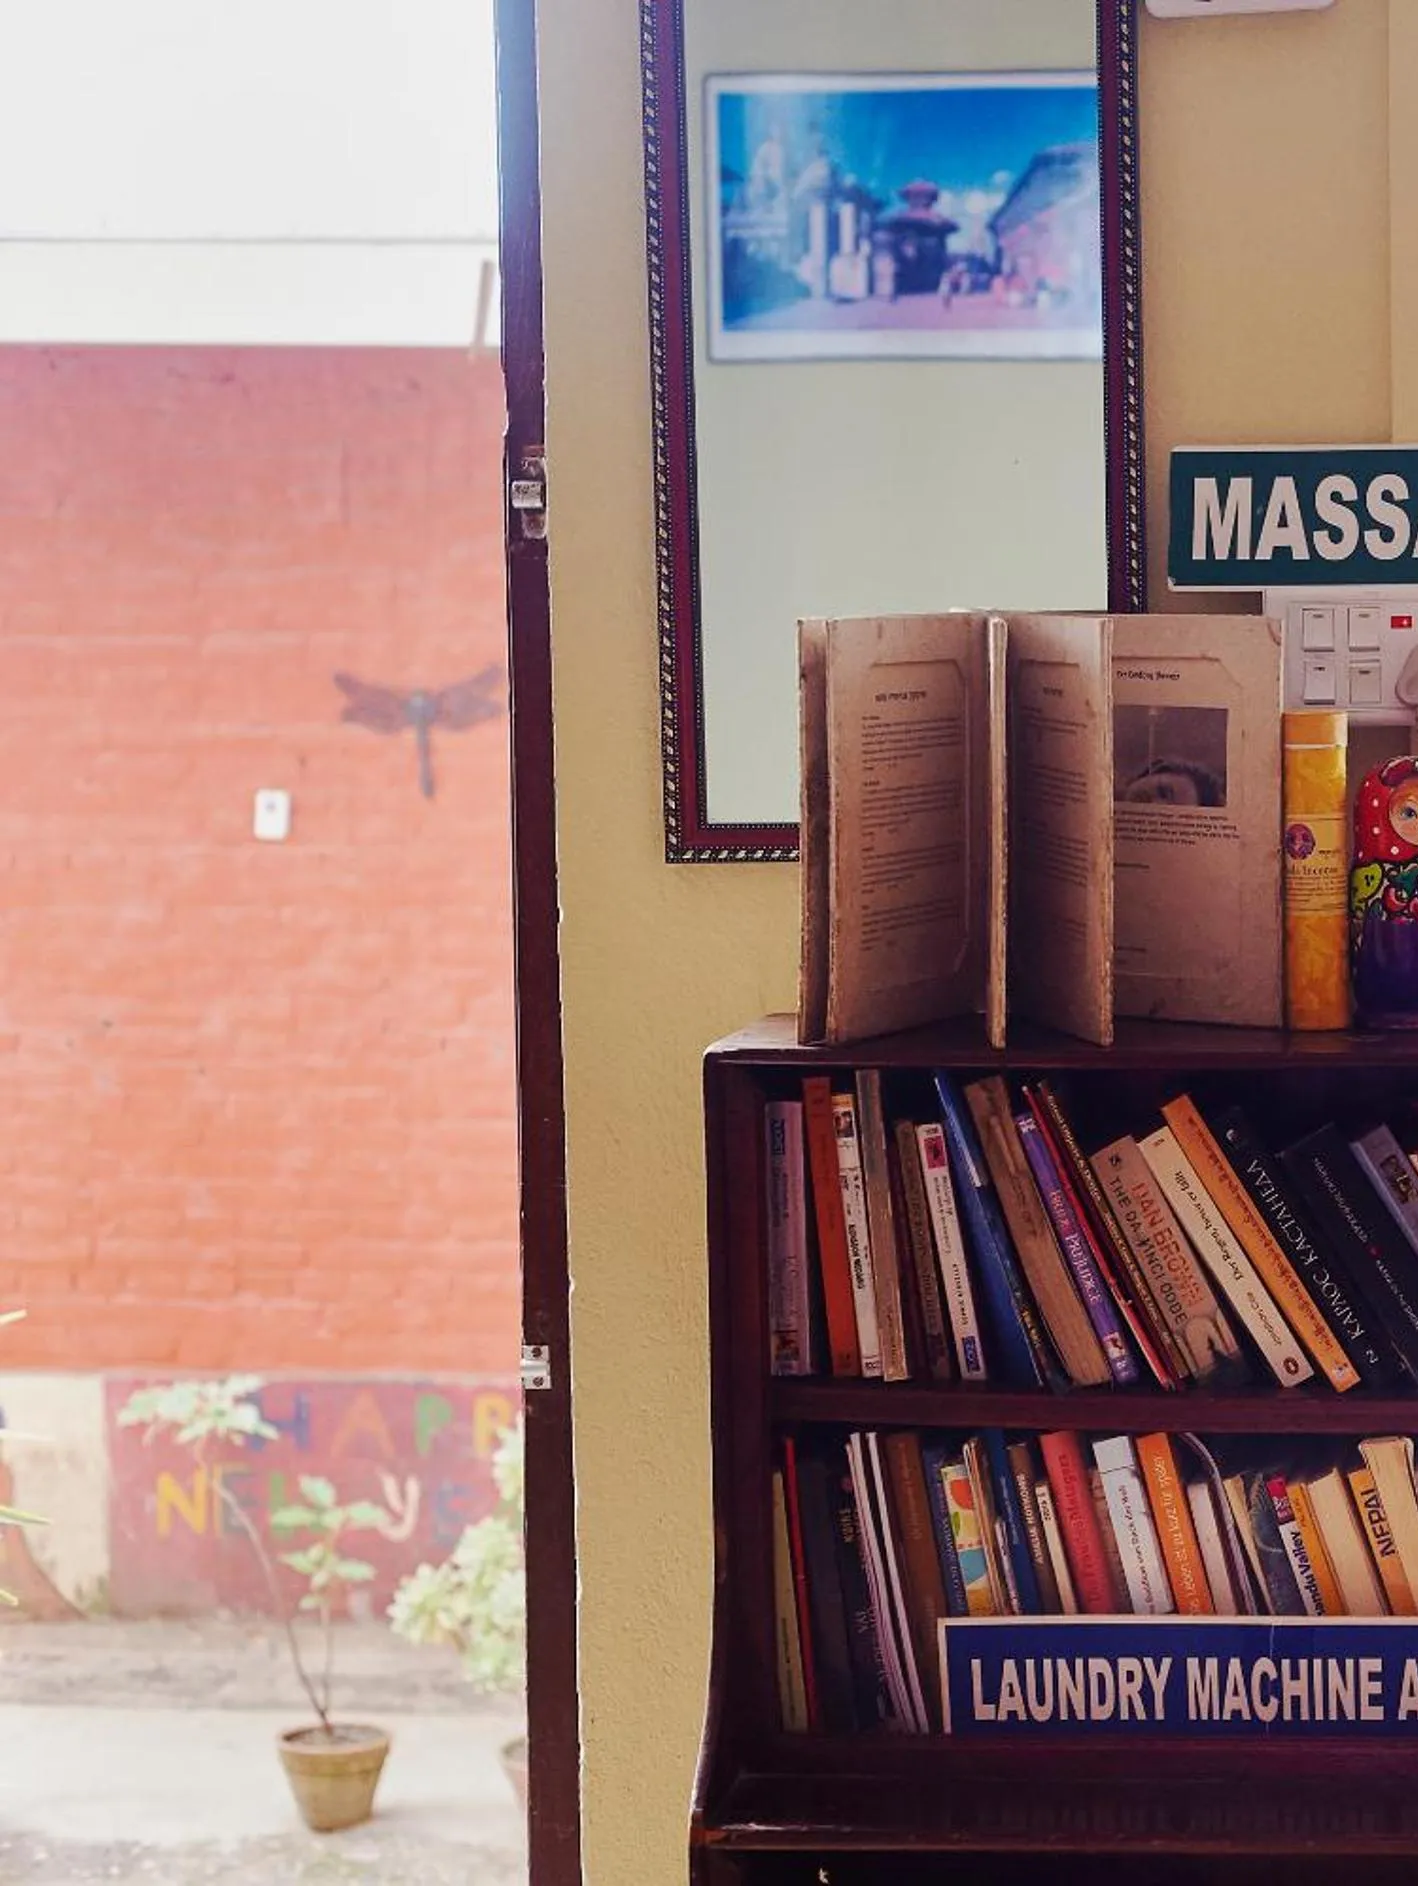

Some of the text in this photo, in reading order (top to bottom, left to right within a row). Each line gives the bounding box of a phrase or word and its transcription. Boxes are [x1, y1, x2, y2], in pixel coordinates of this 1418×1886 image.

[1130, 1180, 1166, 1228] DAN
[1243, 1157, 1320, 1267] КАСТАНЕДА
[1062, 1231, 1104, 1307] PREJUDICE
[1107, 1175, 1131, 1208] THE
[1123, 1209, 1144, 1233] DA
[1158, 1280, 1189, 1326] CODE
[246, 1390, 524, 1456] HAPP
[1283, 1528, 1316, 1575] Valley
[971, 1656, 1173, 1721] LAUNDRY
[1186, 1656, 1385, 1721] MACHINE
